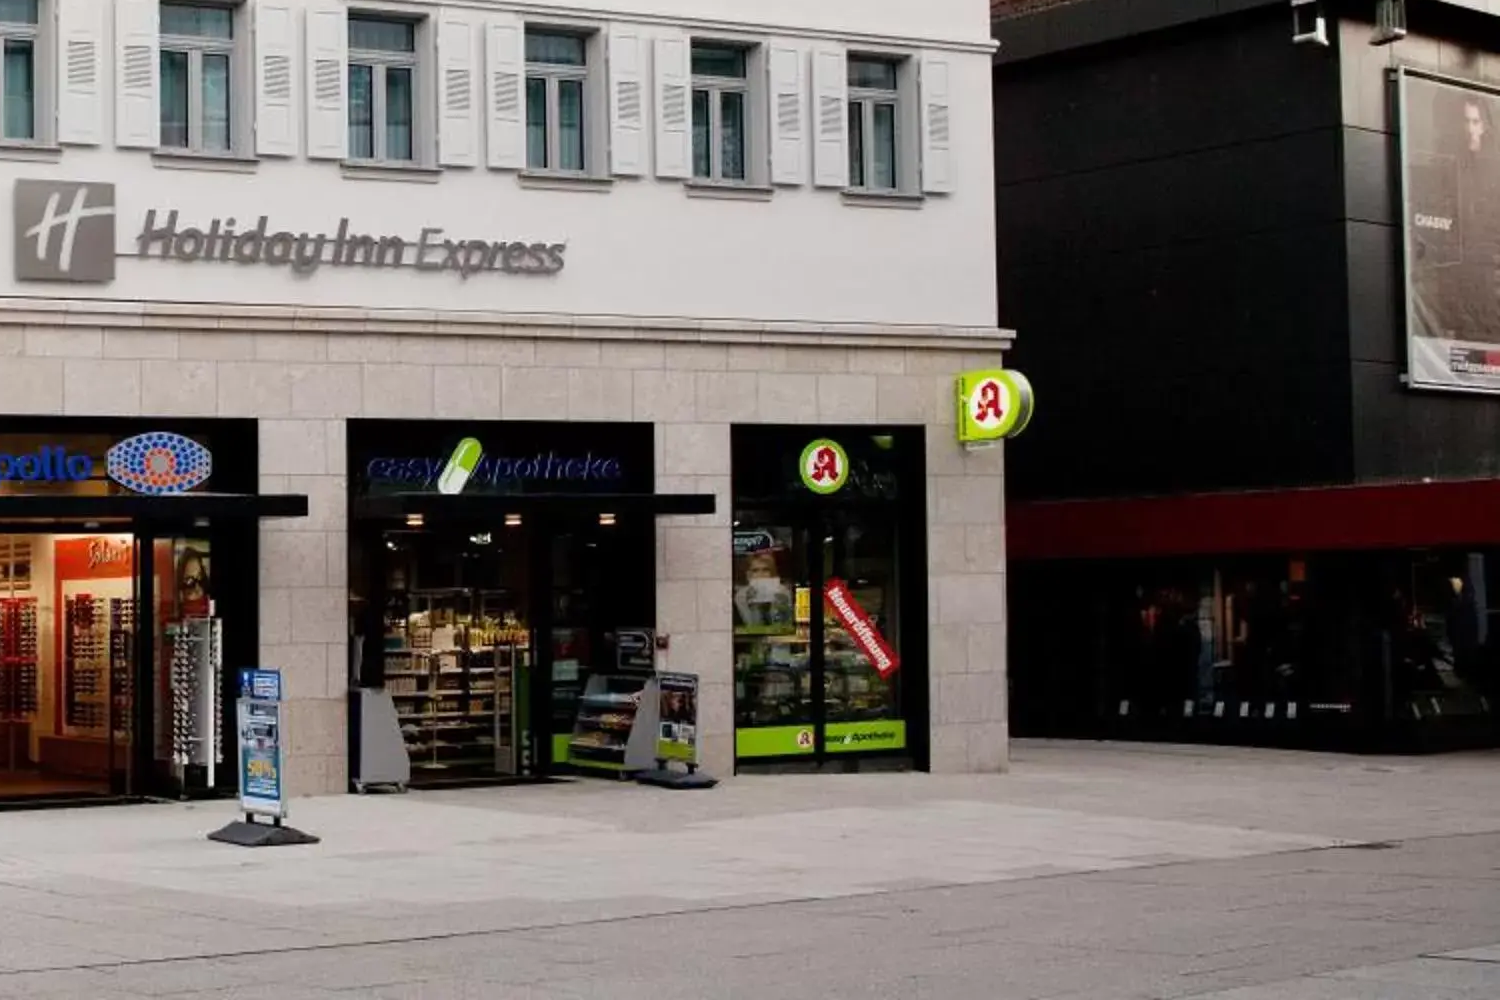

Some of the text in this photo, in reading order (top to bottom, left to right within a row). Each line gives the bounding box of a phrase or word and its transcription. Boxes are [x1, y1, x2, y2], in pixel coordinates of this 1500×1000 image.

[137, 209, 566, 281] Holiday Inn Express
[367, 457, 442, 489] easy
